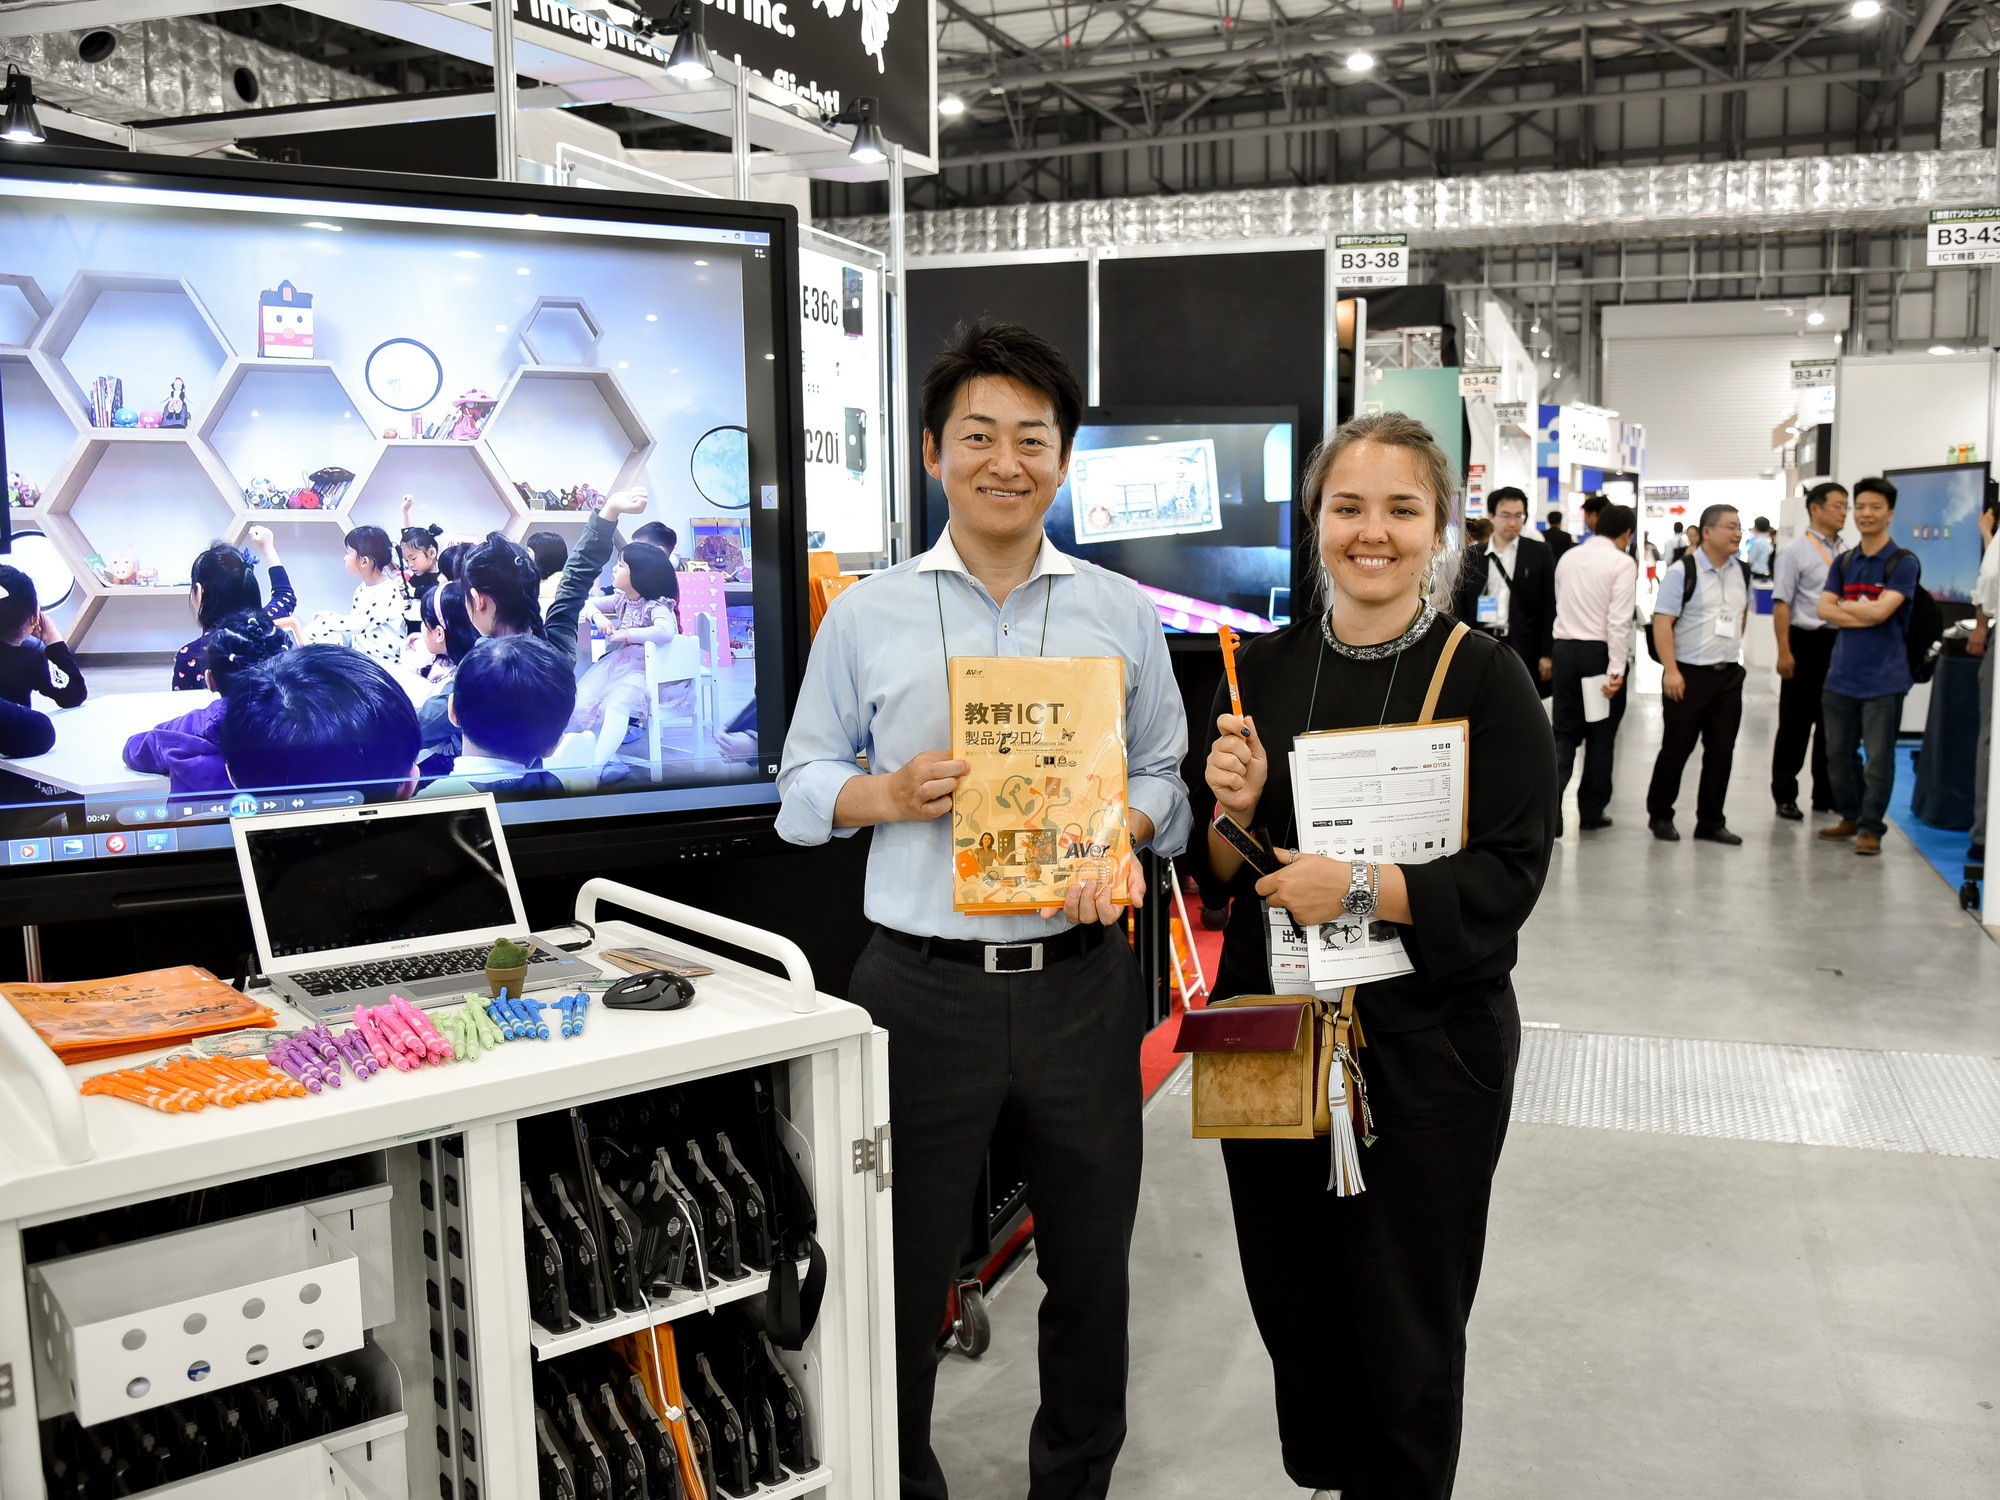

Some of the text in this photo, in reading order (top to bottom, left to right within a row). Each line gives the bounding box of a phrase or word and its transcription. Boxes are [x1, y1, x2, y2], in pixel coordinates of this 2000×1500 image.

[1938, 226, 2000, 245] B3-43
[1341, 252, 1399, 269] B3-38
[964, 702, 1065, 725] 教育ICT
[964, 730, 1043, 746] 製品カタログ
[86, 814, 111, 823] 00:47
[1064, 842, 1111, 858] AVer
[391, 943, 411, 951] SONY
